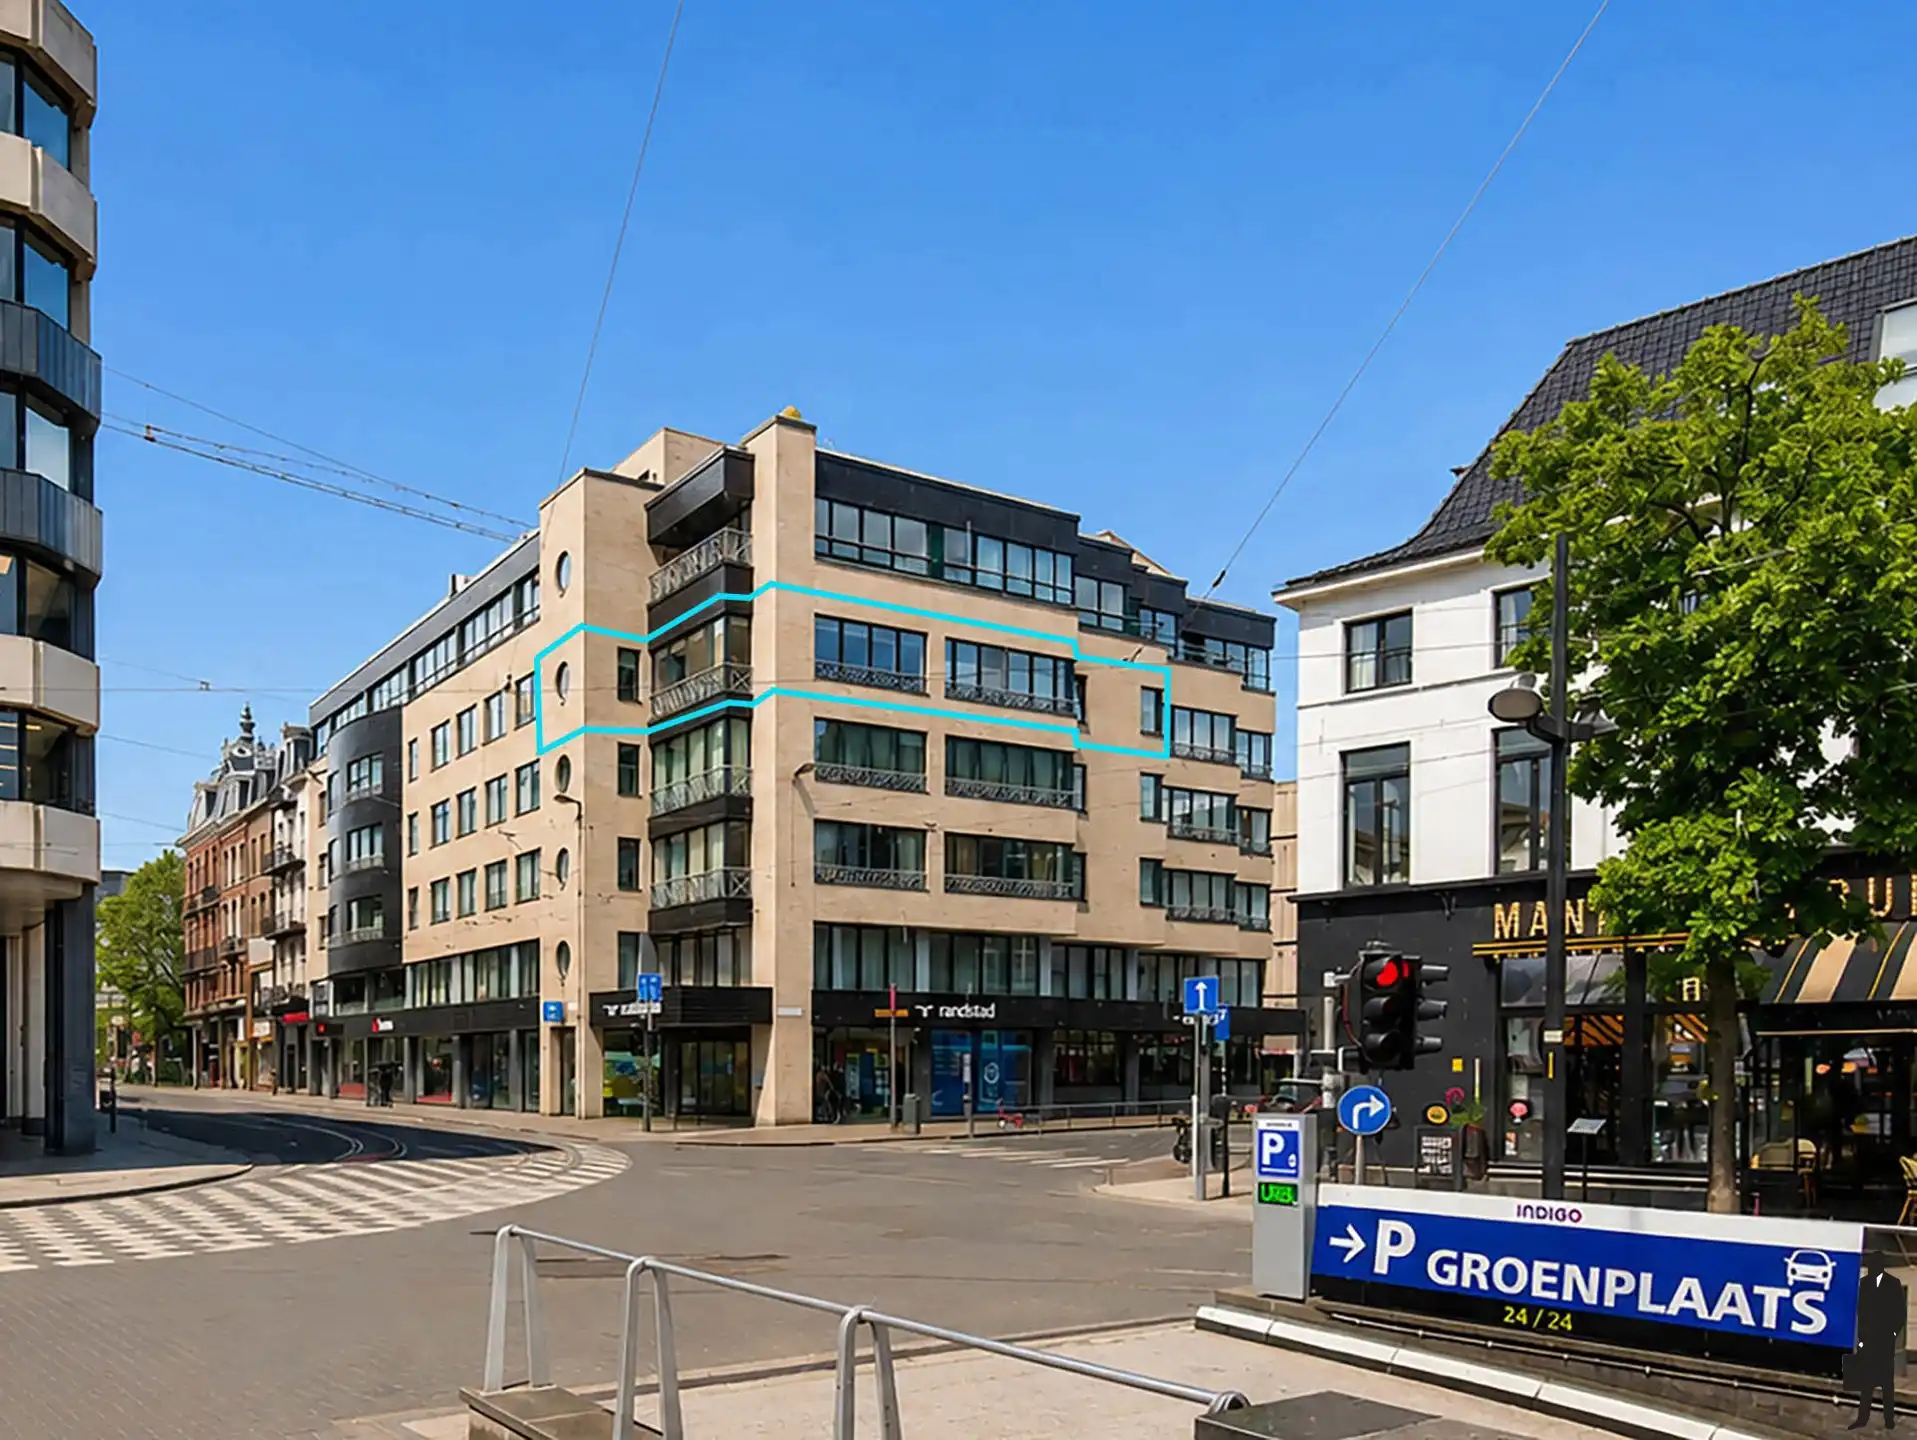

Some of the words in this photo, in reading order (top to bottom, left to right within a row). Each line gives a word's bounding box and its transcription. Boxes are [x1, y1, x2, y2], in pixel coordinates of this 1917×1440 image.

[1262, 1132, 1285, 1165] P
[1516, 1204, 1583, 1223] INDIGO
[1373, 1218, 1416, 1275] P
[1426, 1248, 1828, 1335] GROENPLAATS
[1503, 1306, 1527, 1326] 24
[1548, 1311, 1573, 1331] 24
